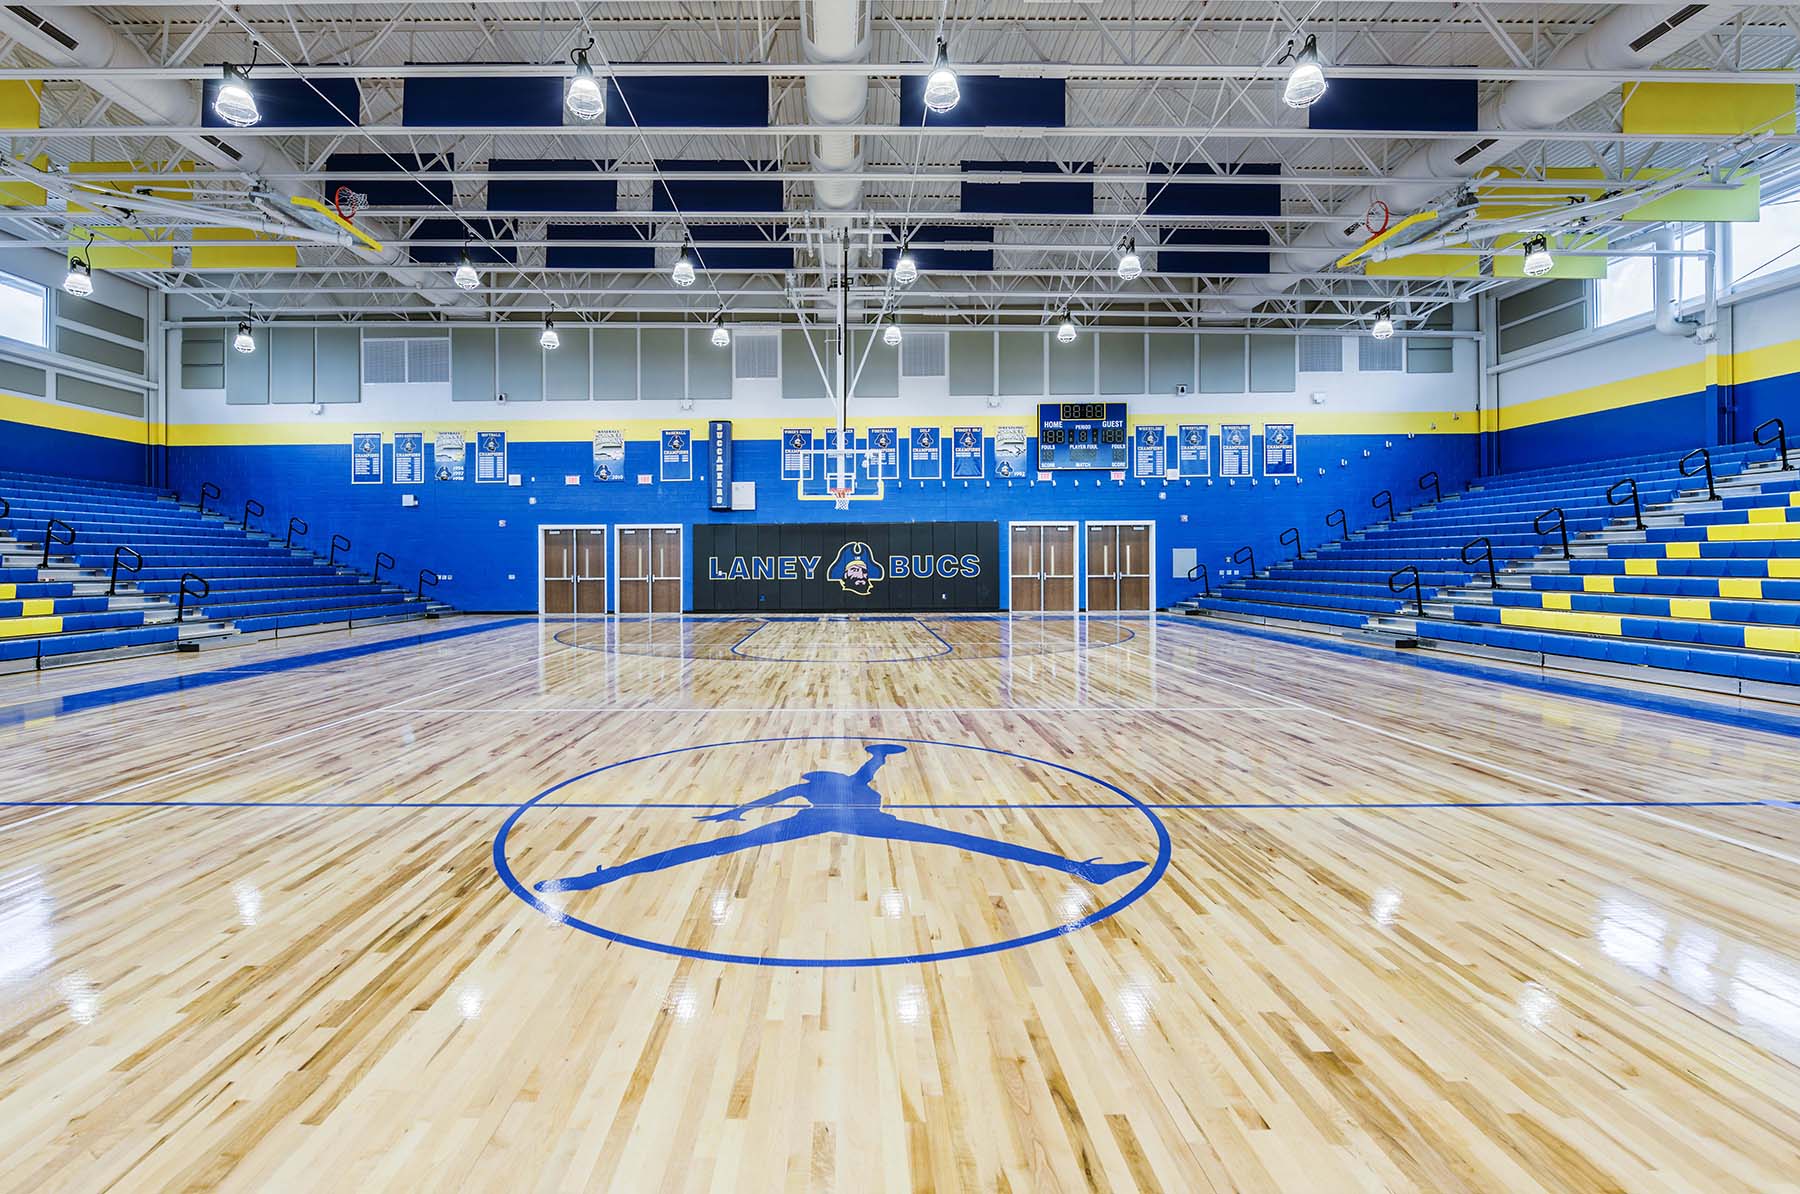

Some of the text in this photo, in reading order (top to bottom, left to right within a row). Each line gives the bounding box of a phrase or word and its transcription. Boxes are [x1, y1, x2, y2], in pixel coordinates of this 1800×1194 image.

[1102, 420, 1124, 428] GUEST
[716, 423, 724, 504] BUCCANEERS
[709, 554, 981, 580] LANEY BUCS
